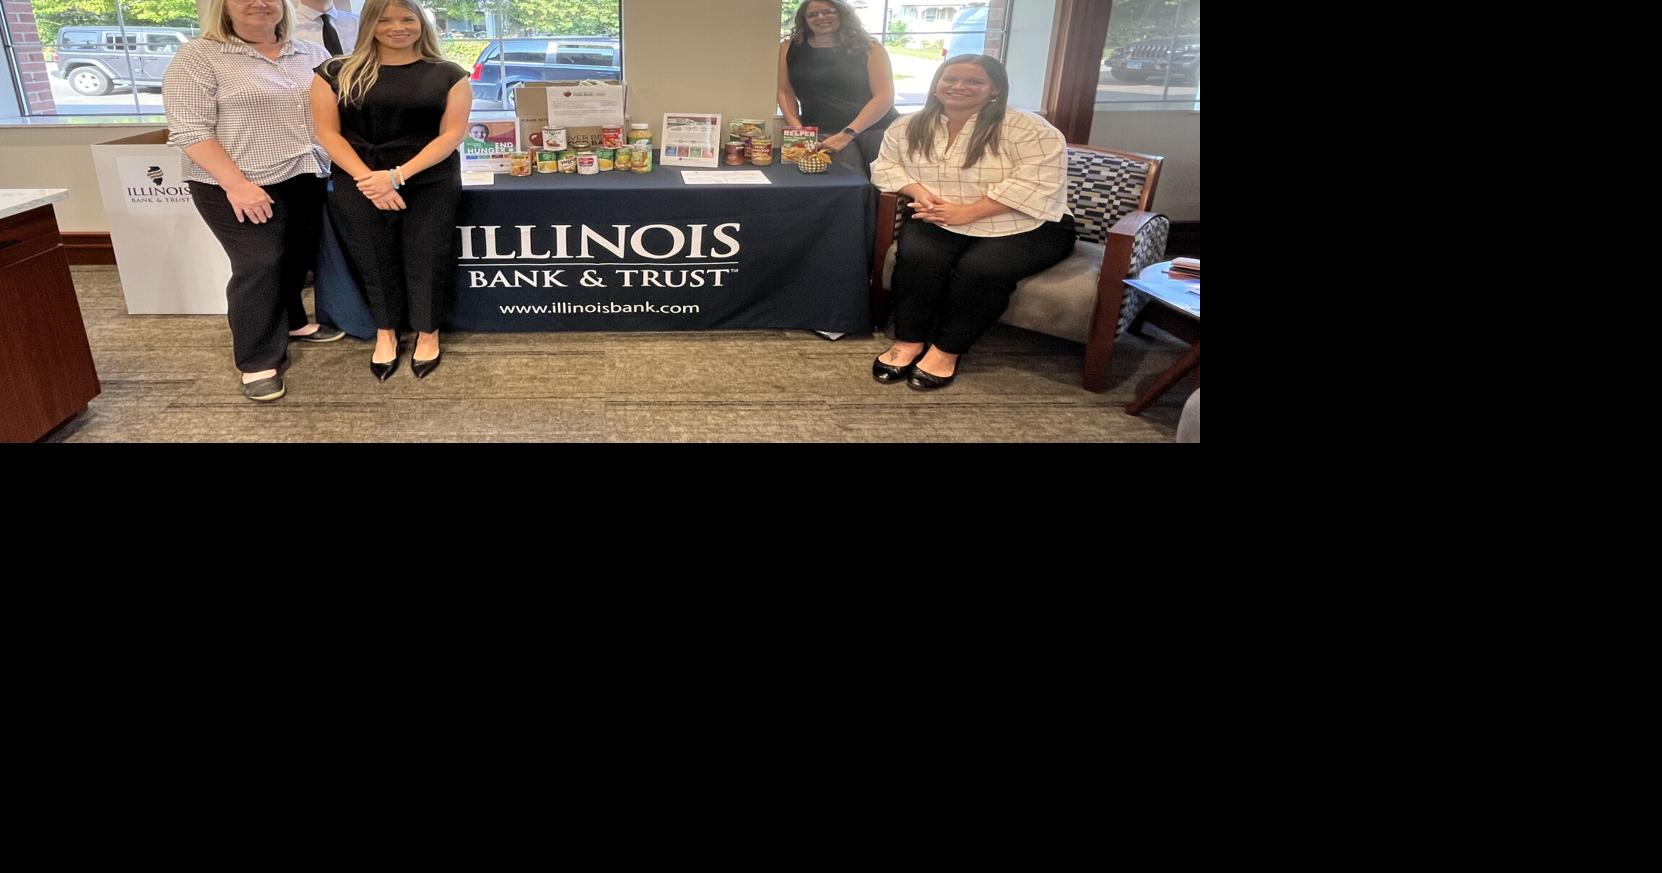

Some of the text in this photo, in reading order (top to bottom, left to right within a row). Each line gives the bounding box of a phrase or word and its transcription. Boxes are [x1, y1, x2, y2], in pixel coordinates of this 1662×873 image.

[784, 129, 815, 137] HELPER
[128, 187, 192, 196] ILLINOIS
[455, 222, 741, 260] ILLINOIS
[468, 269, 569, 288] BANK
[579, 269, 608, 288] &
[500, 300, 700, 315] www.illinoisbank.com
